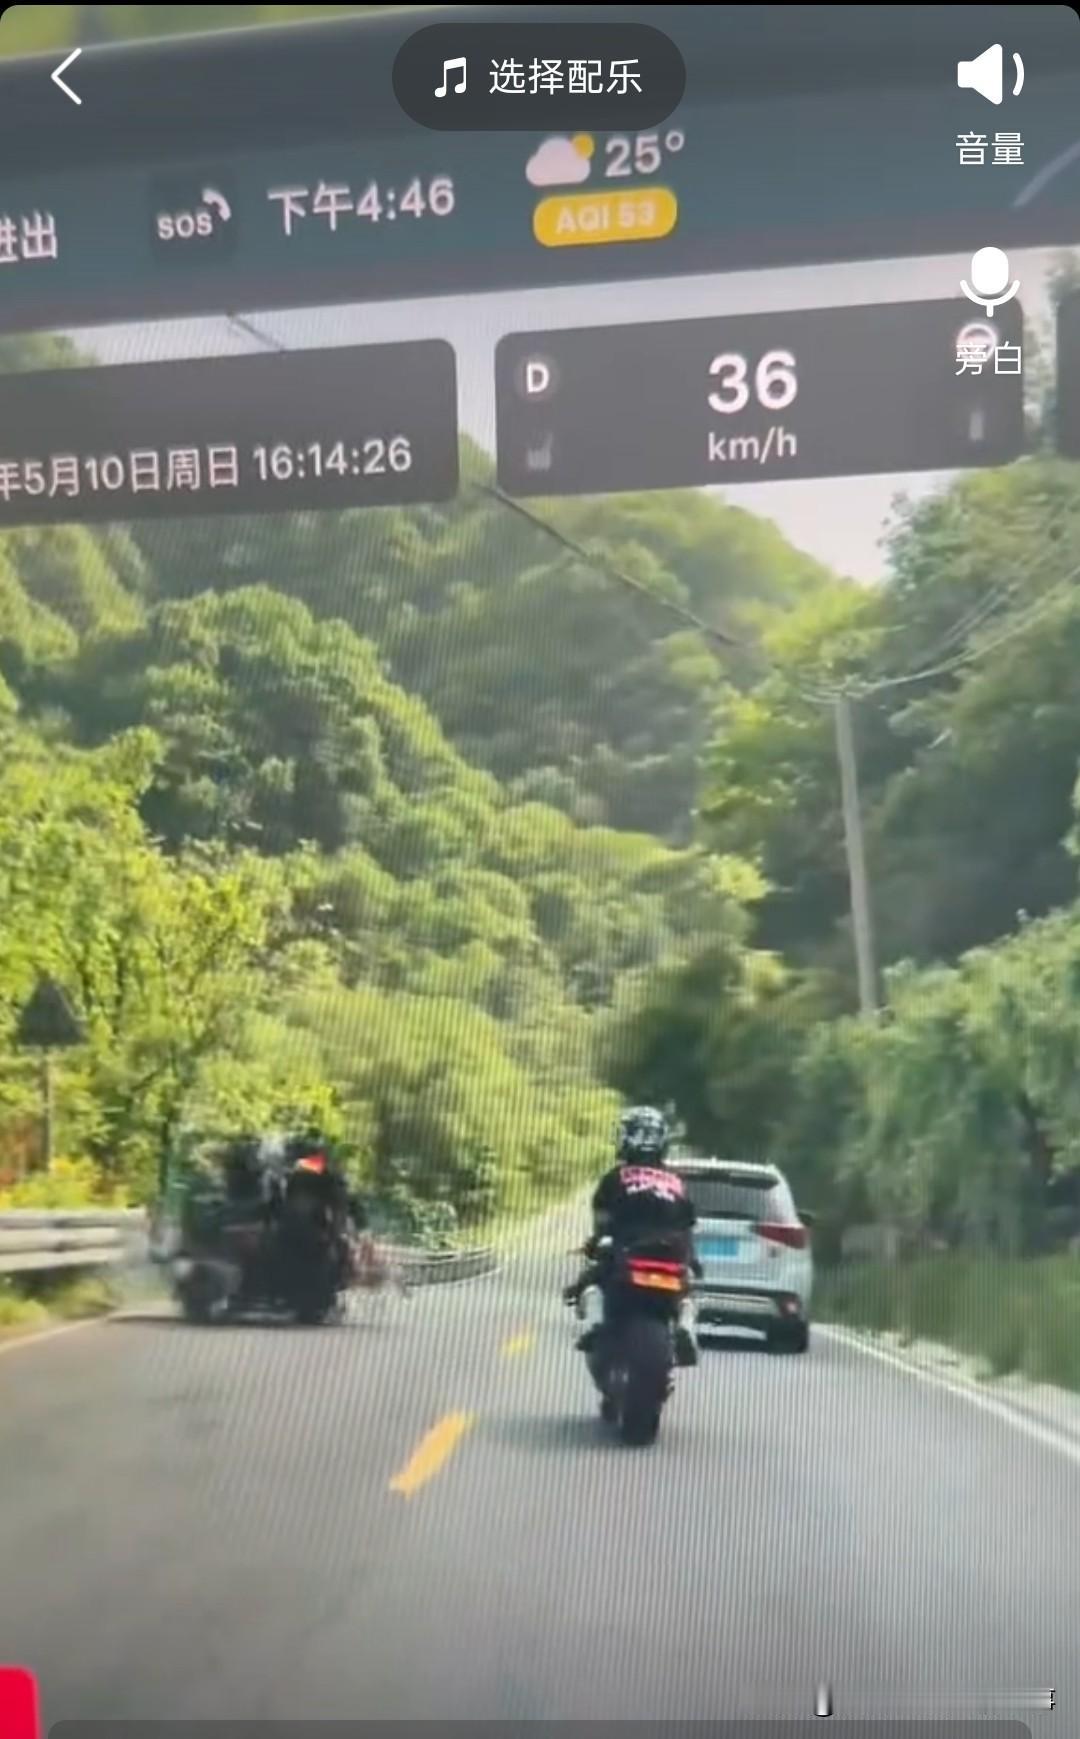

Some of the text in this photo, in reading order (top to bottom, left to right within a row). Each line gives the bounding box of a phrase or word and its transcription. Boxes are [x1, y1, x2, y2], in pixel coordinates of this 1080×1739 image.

[267, 178, 455, 236] 下午4:46
[555, 200, 657, 235] AQI 53
[526, 360, 550, 393] D
[707, 350, 799, 414] 36
[252, 437, 412, 481] 16:14:26
[707, 427, 798, 463] km/h
